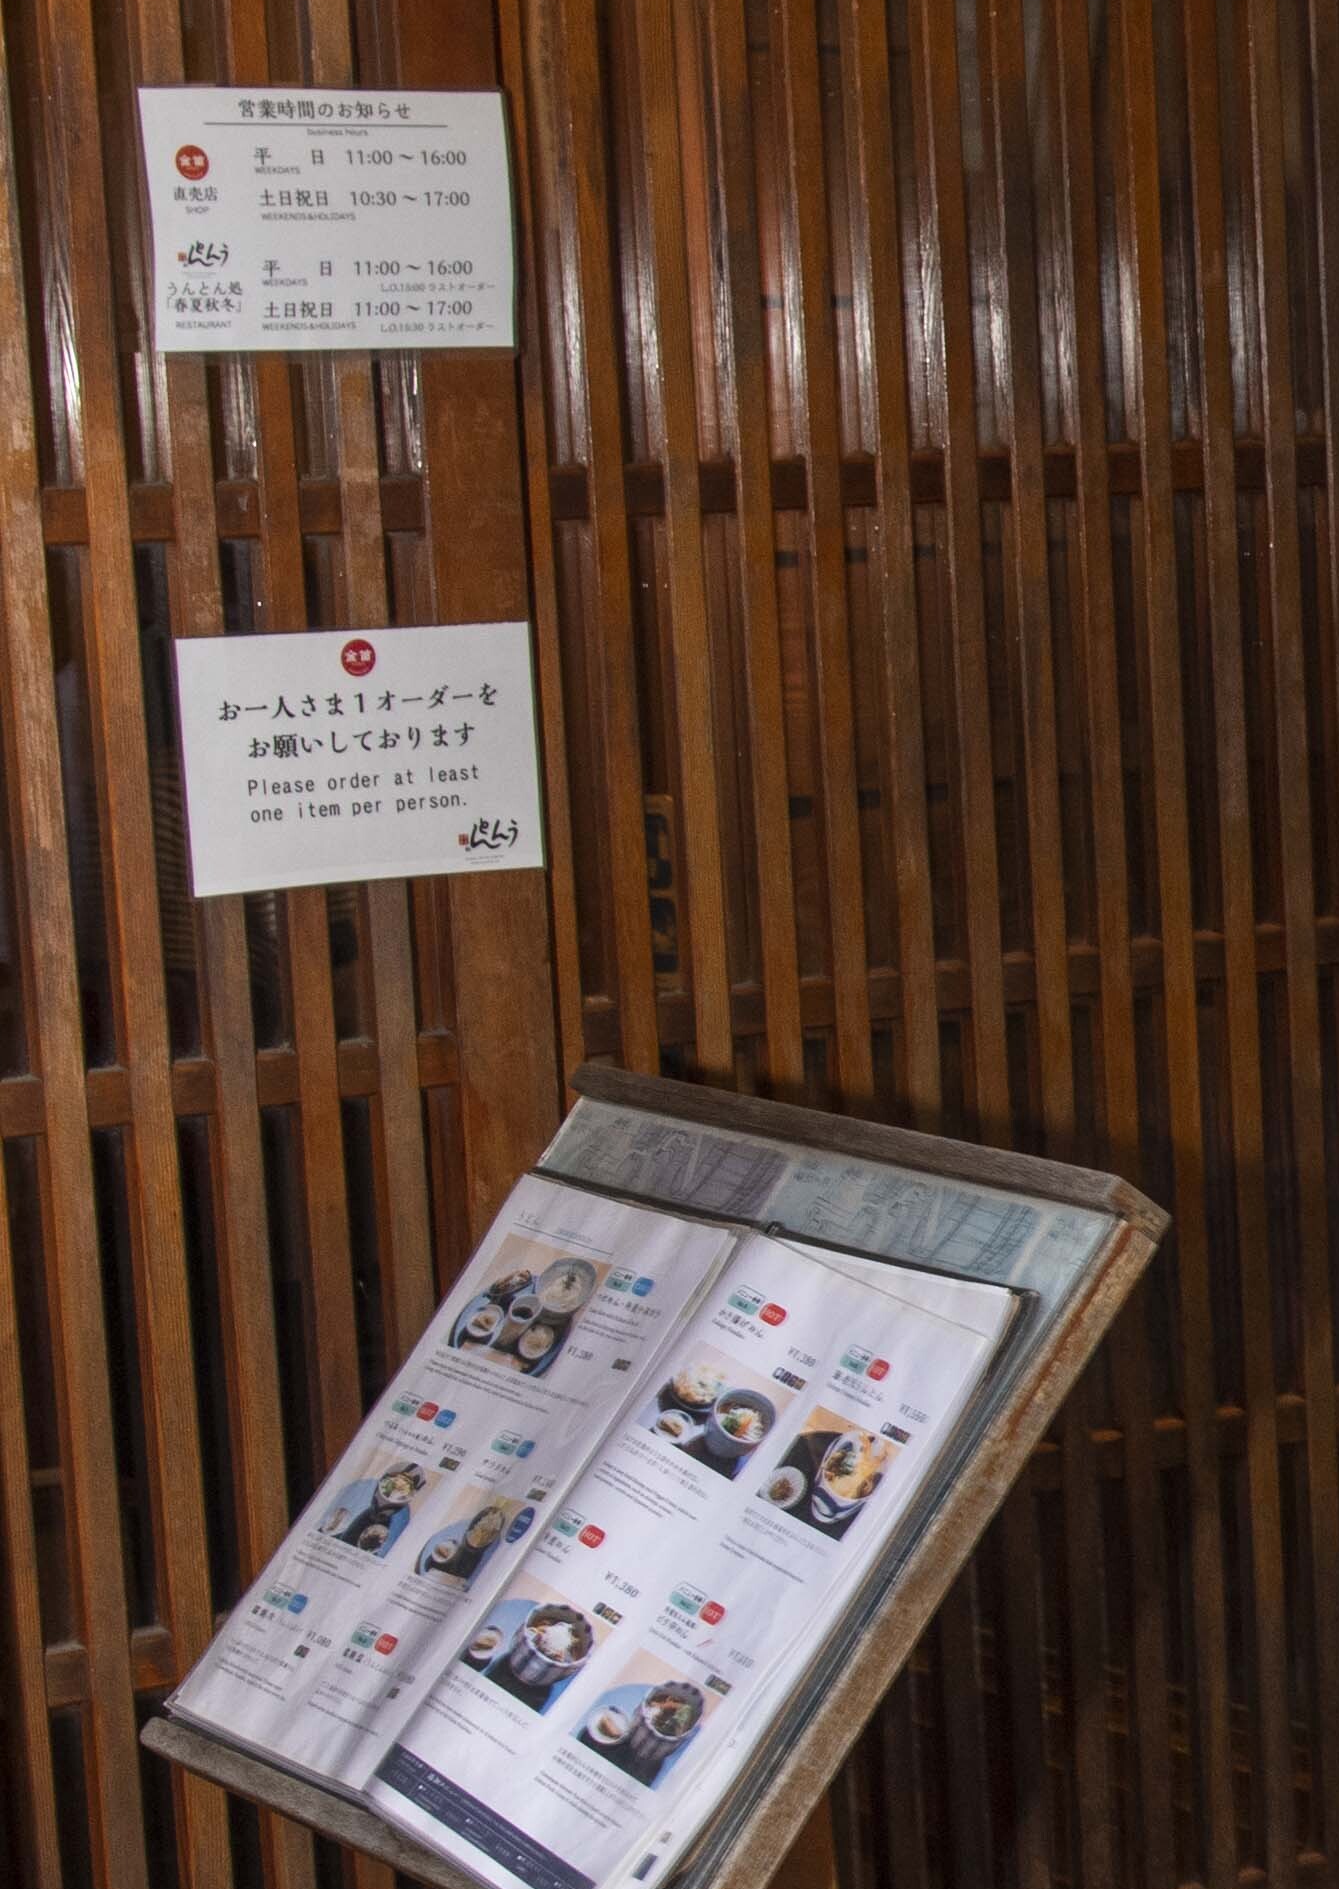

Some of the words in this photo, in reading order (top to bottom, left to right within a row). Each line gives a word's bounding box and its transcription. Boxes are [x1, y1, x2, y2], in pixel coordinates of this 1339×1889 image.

[238, 99, 411, 120] 営業時間のお知らせ
[306, 127, 342, 136] business
[345, 127, 369, 136] hours
[346, 150, 393, 166] 11:00
[421, 150, 467, 166] 16:00
[255, 166, 300, 175] WEEKDAYS
[174, 186, 218, 201] 直売店
[259, 190, 329, 207] 土日祝日
[350, 191, 396, 207] 10:30
[424, 192, 470, 207] 17:00
[186, 206, 209, 214] SHOP
[353, 261, 400, 276] 11:00
[428, 261, 473, 276] 16:00
[168, 281, 243, 296] うんとん処
[262, 278, 308, 287] WEEKDAYS
[167, 297, 242, 313] 「春夏秋冬」
[264, 301, 333, 318] 土日祝日
[354, 301, 399, 316] 11:00
[427, 300, 472, 315] 17:00
[176, 320, 232, 329] RESTAURANT
[218, 683, 498, 722] お一人さま1オーダーを
[248, 722, 476, 760] お願いしております
[247, 776, 315, 797] Please
[327, 771, 380, 792] order
[393, 768, 414, 785] at
[429, 764, 480, 784] least
[250, 805, 284, 823] one
[298, 801, 342, 820] item
[352, 799, 383, 816] per
[396, 792, 468, 814] person.
[604, 1570, 640, 1598] ¥1,380
